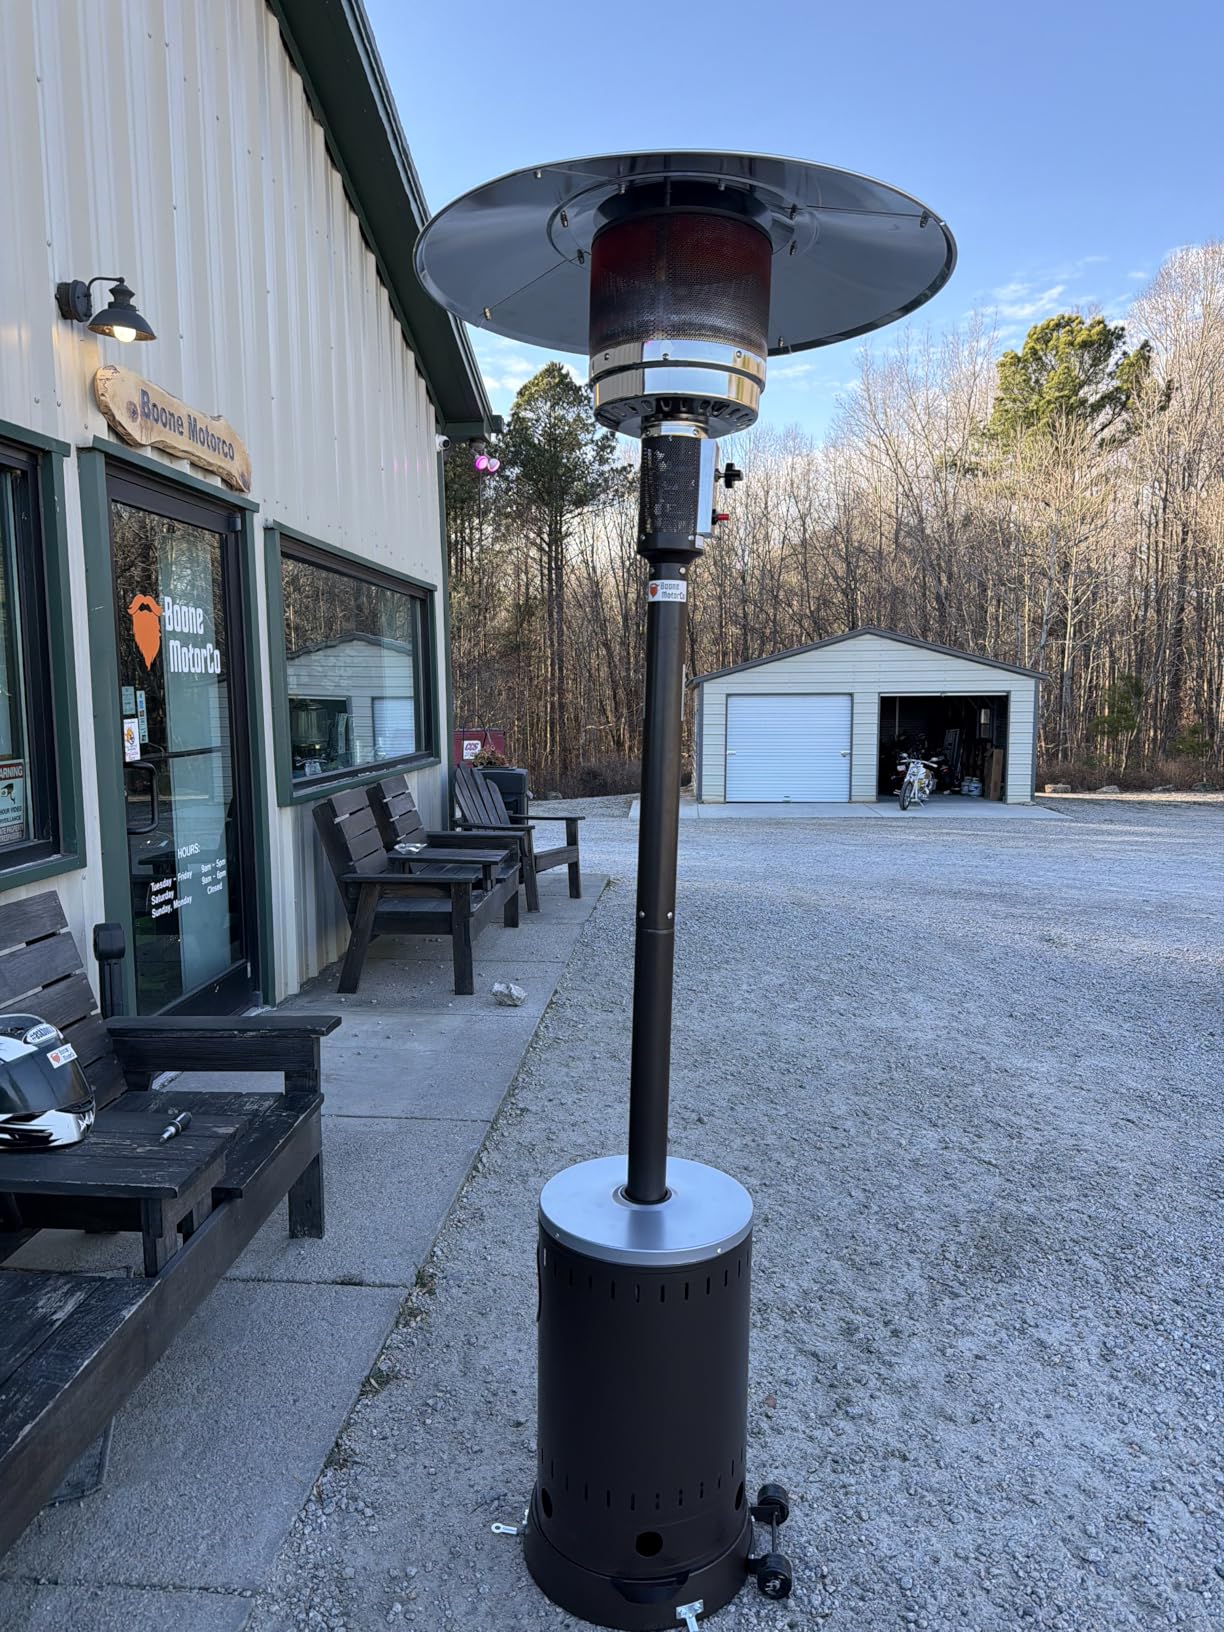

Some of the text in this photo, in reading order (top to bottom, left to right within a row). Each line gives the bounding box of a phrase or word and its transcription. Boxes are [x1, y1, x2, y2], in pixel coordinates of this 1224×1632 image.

[140, 388, 235, 461] Boone Motorco
[163, 596, 204, 634] Boone
[169, 640, 221, 674] MotorCo
[0, 766, 22, 778] ARNING
[178, 843, 200, 858] HOURS:
[150, 877, 172, 892] Tuesday
[177, 870, 193, 882] Friday
[151, 890, 175, 905] Saturday
[151, 882, 222, 919] Sunday, Monday Closed
